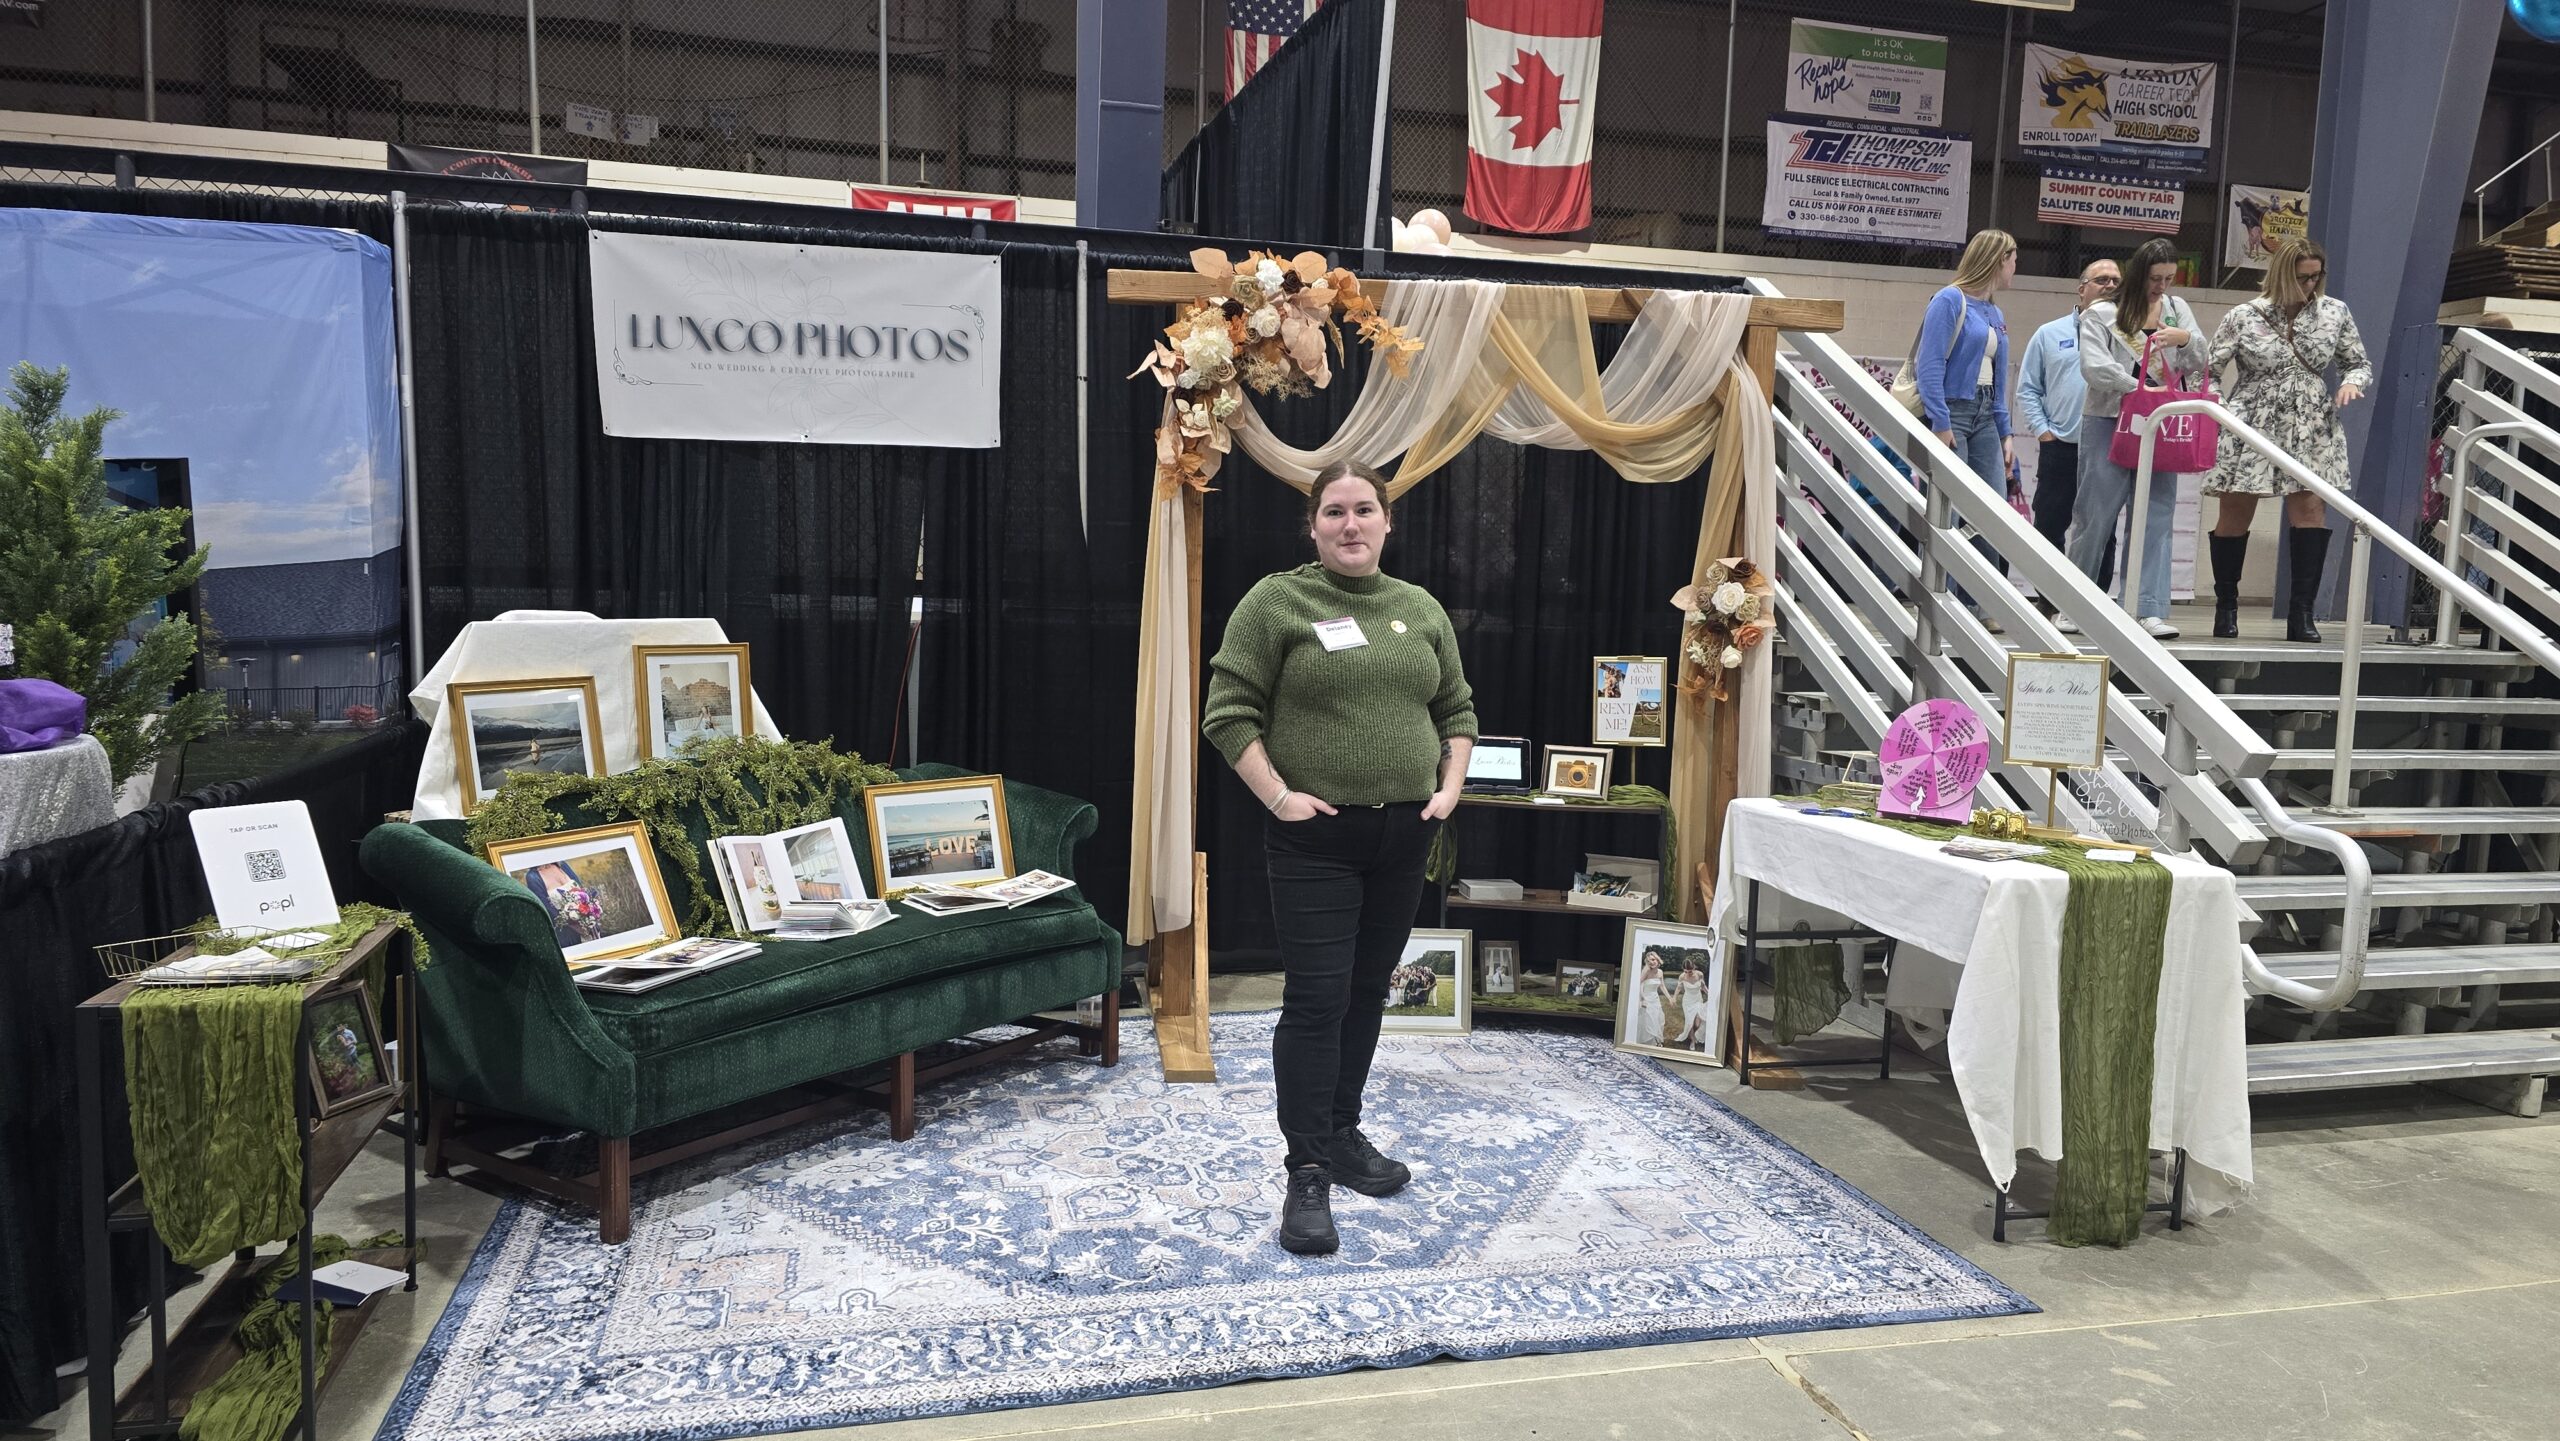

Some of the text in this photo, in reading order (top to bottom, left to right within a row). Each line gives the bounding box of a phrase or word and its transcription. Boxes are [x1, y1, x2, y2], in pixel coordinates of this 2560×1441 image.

[1890, 39, 1903, 49] OK
[1873, 50, 1888, 59] not
[1890, 51, 1901, 60] be
[1795, 54, 1853, 90] Recover
[2120, 68, 2201, 87] AKRON
[1813, 74, 1854, 104] hope.
[1869, 89, 1890, 99] ADM
[2118, 83, 2200, 103] CAREER TECH
[2113, 100, 2198, 120] HIGH SCHOOL
[1826, 120, 1920, 135] RESIDENTIAL COMMERCIAL INDUSTRIAL
[2022, 130, 2097, 143] ENROLL TODAY!
[2114, 120, 2200, 143] TRAILBLAZERS
[1852, 133, 1952, 158] THOMPSON
[449, 156, 491, 172] COUNTY
[1841, 150, 1926, 172] ELECTRIC
[1784, 172, 1950, 196] FULL SERVICE ELECTRICAL CONTRACTING
[2048, 182, 2175, 205] SUMMIT COUNTY FAIR
[1813, 188, 1832, 198] Local
[1840, 191, 1863, 201] Family
[1864, 193, 1890, 203] Owned,
[1904, 197, 1920, 205] 1977
[1789, 199, 1942, 220] CALL US NOW FOR A FREE ESTIMATE!
[1800, 212, 1860, 225] 330-686-2300
[2040, 197, 2180, 221] SALUTES OUR MILITARY!
[629, 313, 970, 362] LUXCO PHOTOS
[690, 361, 915, 379] NEO WEDDING & CREATIVE PHOTOGRAPHER
[2115, 411, 2193, 437] LVE
[1633, 664, 1654, 673] ASK
[1630, 675, 1656, 685] HOW
[2018, 680, 2098, 696] Spin to Win!
[1635, 687, 1648, 696] TO
[1600, 702, 1633, 714] RENT
[1605, 718, 1627, 730] ME!
[2076, 765, 2120, 796] Sha
[2118, 799, 2166, 819] loe
[258, 823, 278, 831] SCAN
[925, 835, 978, 856] LOVE
[259, 894, 295, 915] popl
